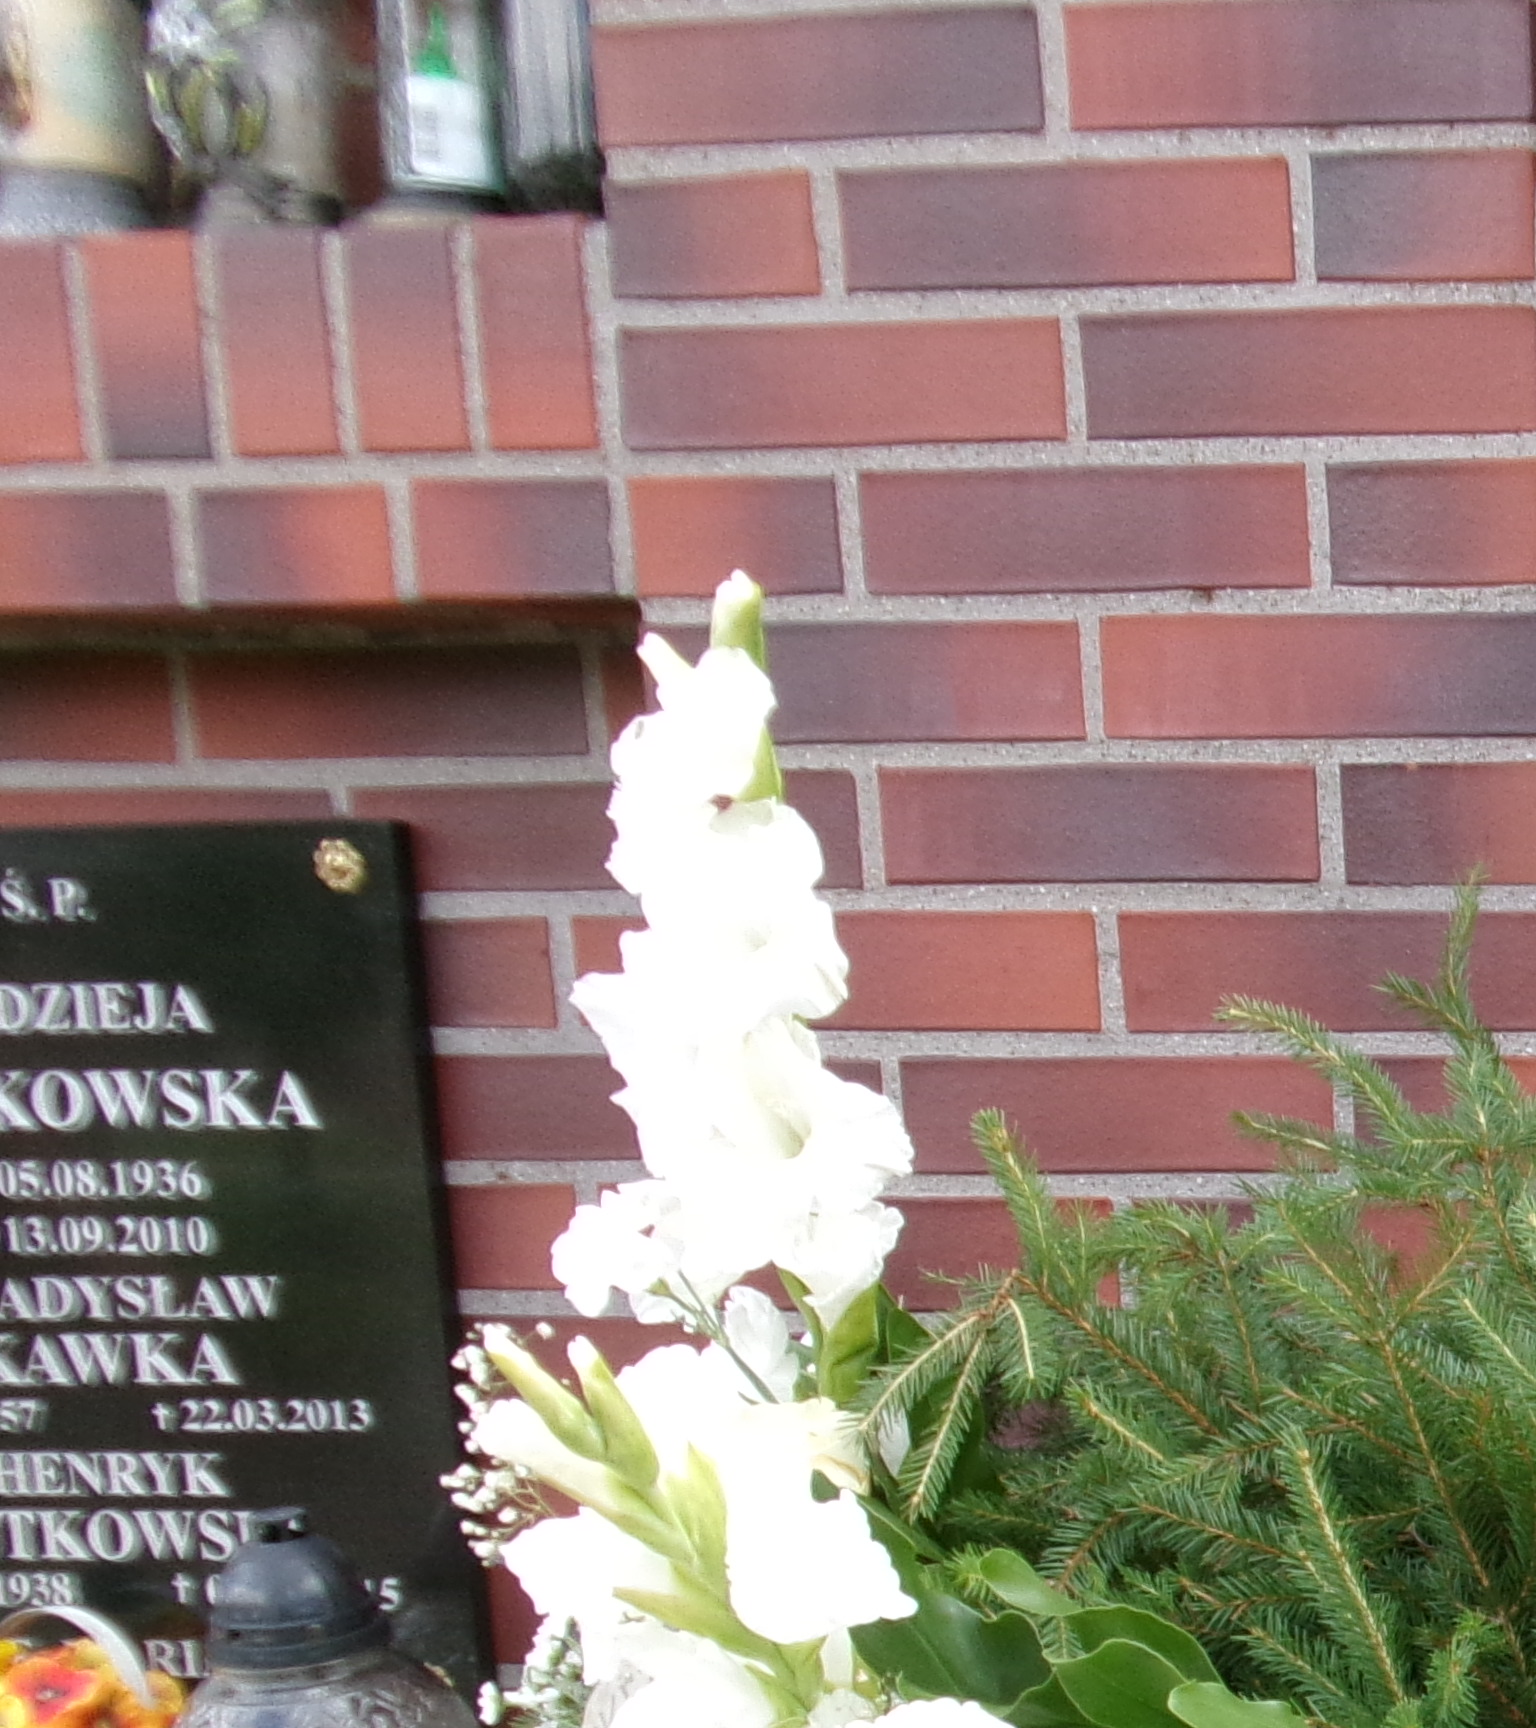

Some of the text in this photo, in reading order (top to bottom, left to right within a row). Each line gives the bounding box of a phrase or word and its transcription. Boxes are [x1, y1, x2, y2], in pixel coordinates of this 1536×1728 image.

[0, 980, 214, 1034] DZIEJA
[0, 1159, 212, 1200] 05.08.1936
[4, 1215, 217, 1255] 13.09.2010
[179, 1399, 375, 1432] 22.03.2013
[0, 1452, 230, 1496] HENRYK
[0, 1508, 304, 1562] TKOWS
